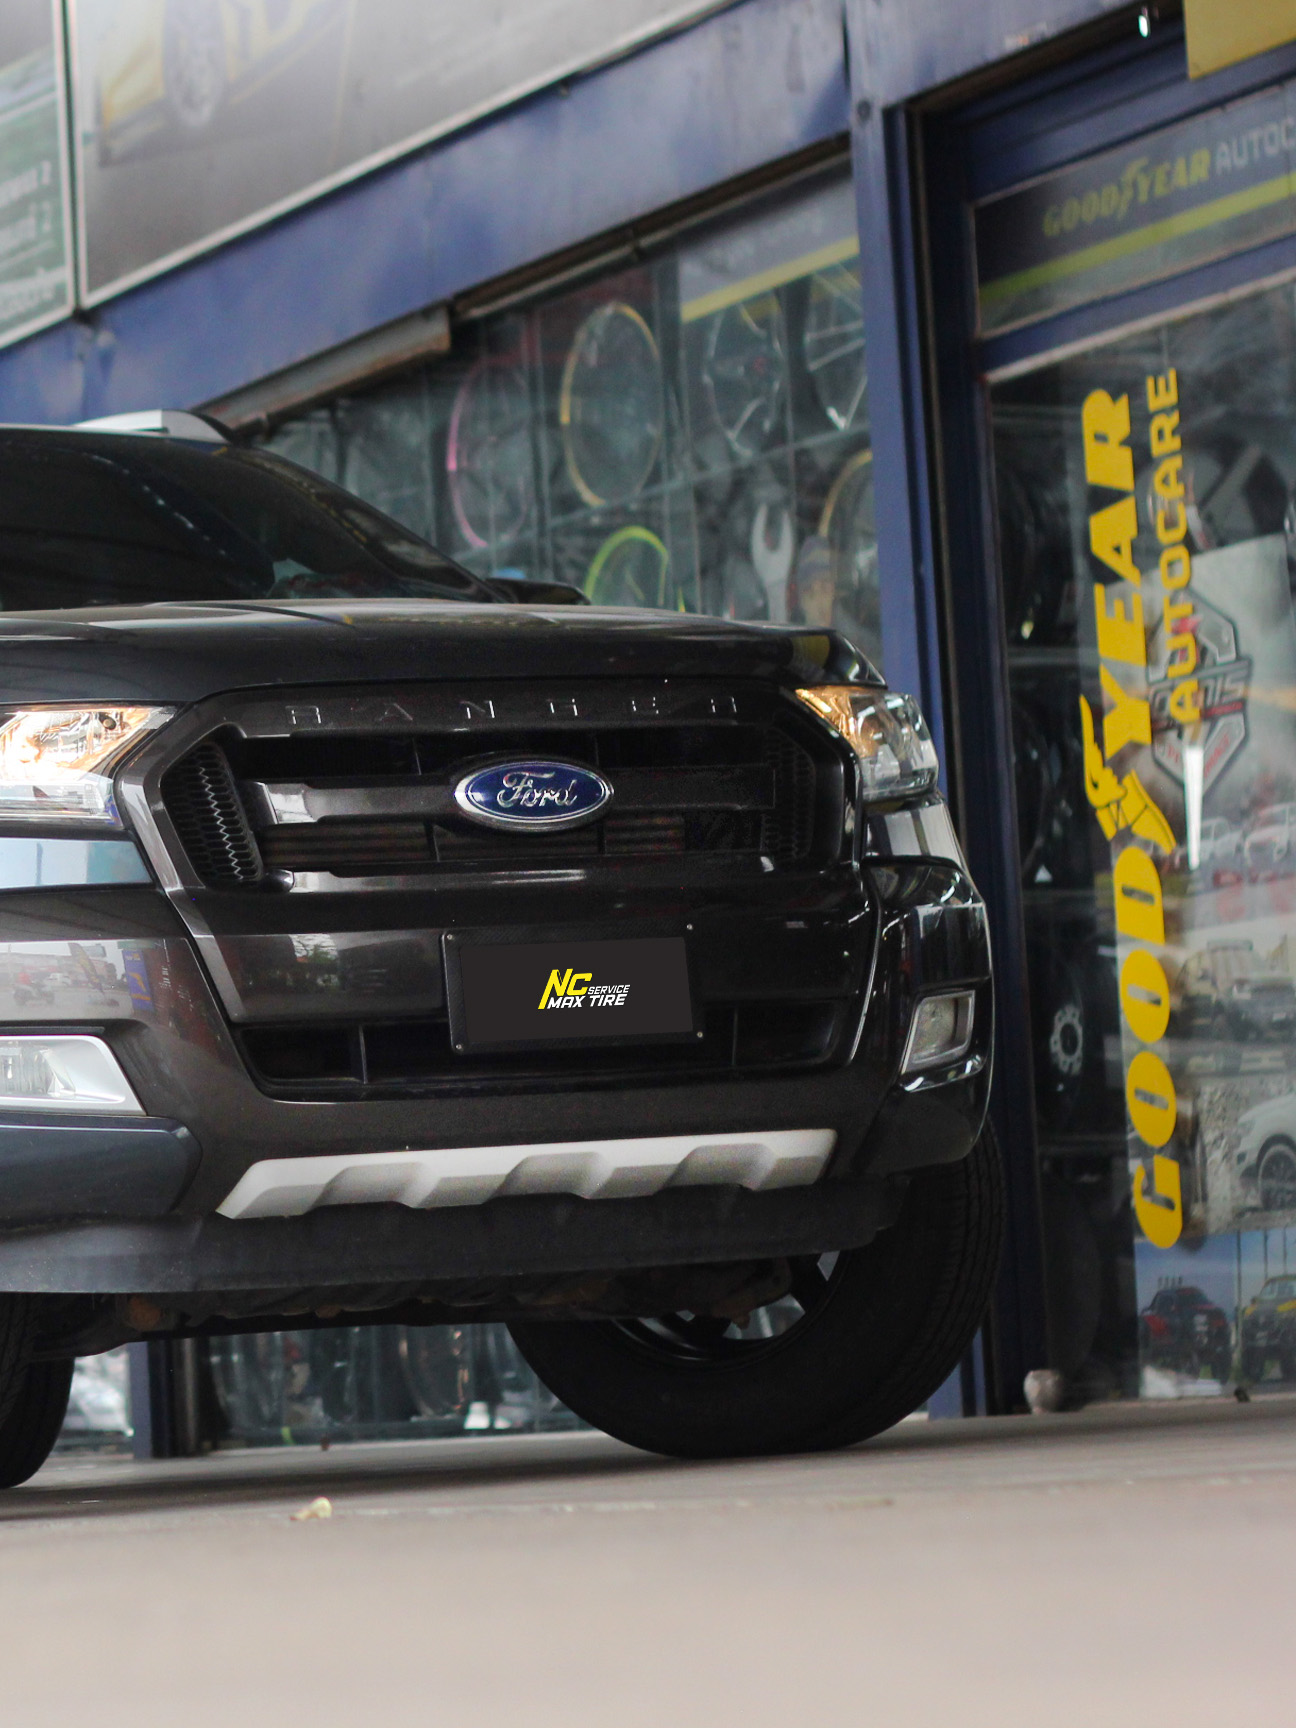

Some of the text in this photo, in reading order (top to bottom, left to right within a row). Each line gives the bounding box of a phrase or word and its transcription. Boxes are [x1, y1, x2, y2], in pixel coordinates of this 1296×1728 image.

[1042, 147, 1212, 238] GOODYEAR
[1146, 368, 1201, 724] AUTOCARE
[497, 771, 578, 808] Ford
